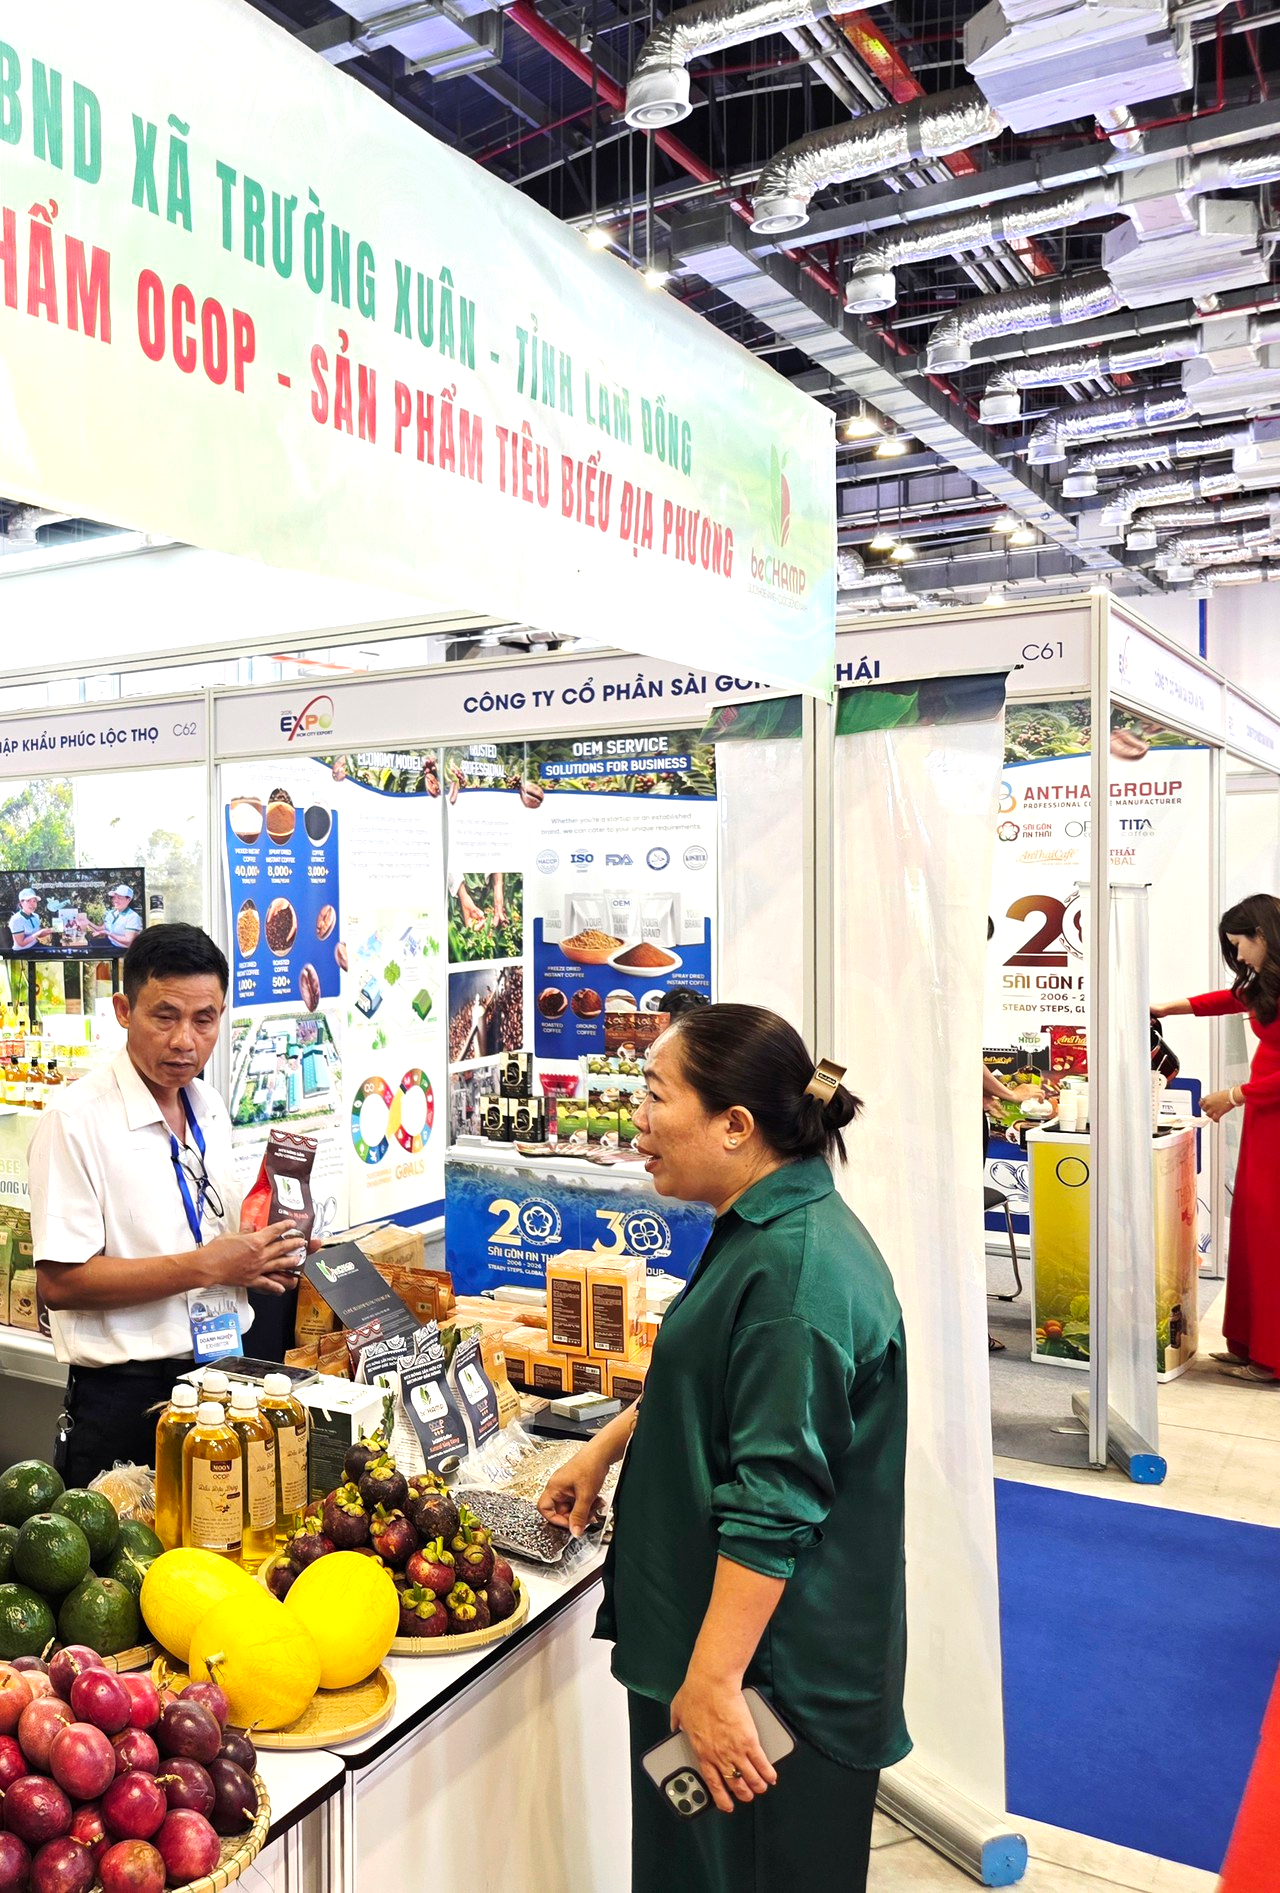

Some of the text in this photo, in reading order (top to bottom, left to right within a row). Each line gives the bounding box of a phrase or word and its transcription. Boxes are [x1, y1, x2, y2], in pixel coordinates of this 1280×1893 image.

[132, 113, 193, 233] XÃ
[216, 160, 376, 322] TRƯỜNG
[394, 260, 476, 370] XUÂN
[490, 350, 500, 364] -
[516, 313, 574, 417] TỈNH
[641, 394, 693, 477] ĐỒNG
[137, 269, 256, 394] OCOP
[278, 372, 291, 389] -
[310, 329, 377, 445] SẢN
[395, 381, 484, 485] PHẨM
[496, 420, 550, 509] TIÊU
[561, 450, 613, 535] BIỂU
[622, 480, 654, 558] ĐỊA
[663, 499, 734, 580] PHƯƠNG
[1021, 641, 1066, 662] C61
[463, 656, 880, 714] CÔNG TY CỔ PHẦN SÀI HÁI
[22, 731, 57, 752] KHẨU
[60, 730, 97, 748] PHÚC
[100, 728, 128, 747] LỘC
[131, 727, 160, 746] THỌ
[173, 722, 198, 737] C62
[573, 737, 669, 757] OEM SERVICE
[545, 757, 688, 776] SOLUTIONS FOR BUSINESS
[1023, 781, 1183, 801] ANTHA GROUP
[1023, 798, 1183, 809] PROFESSIONAL MANUFACTURER
[1119, 819, 1153, 831] TITA
[570, 853, 595, 864] ISO
[605, 853, 634, 867] FDA
[267, 865, 293, 877] 8,000+
[612, 899, 631, 908] OEM
[272, 976, 291, 987] 500+
[1002, 973, 1073, 989] SÀI GÒN
[1040, 993, 1069, 1001] 2006
[1002, 1004, 1073, 1014] STEADY STEPS,
[0, 1180, 19, 1194] ONG
[488, 1245, 539, 1262] SÀI GÒN AN
